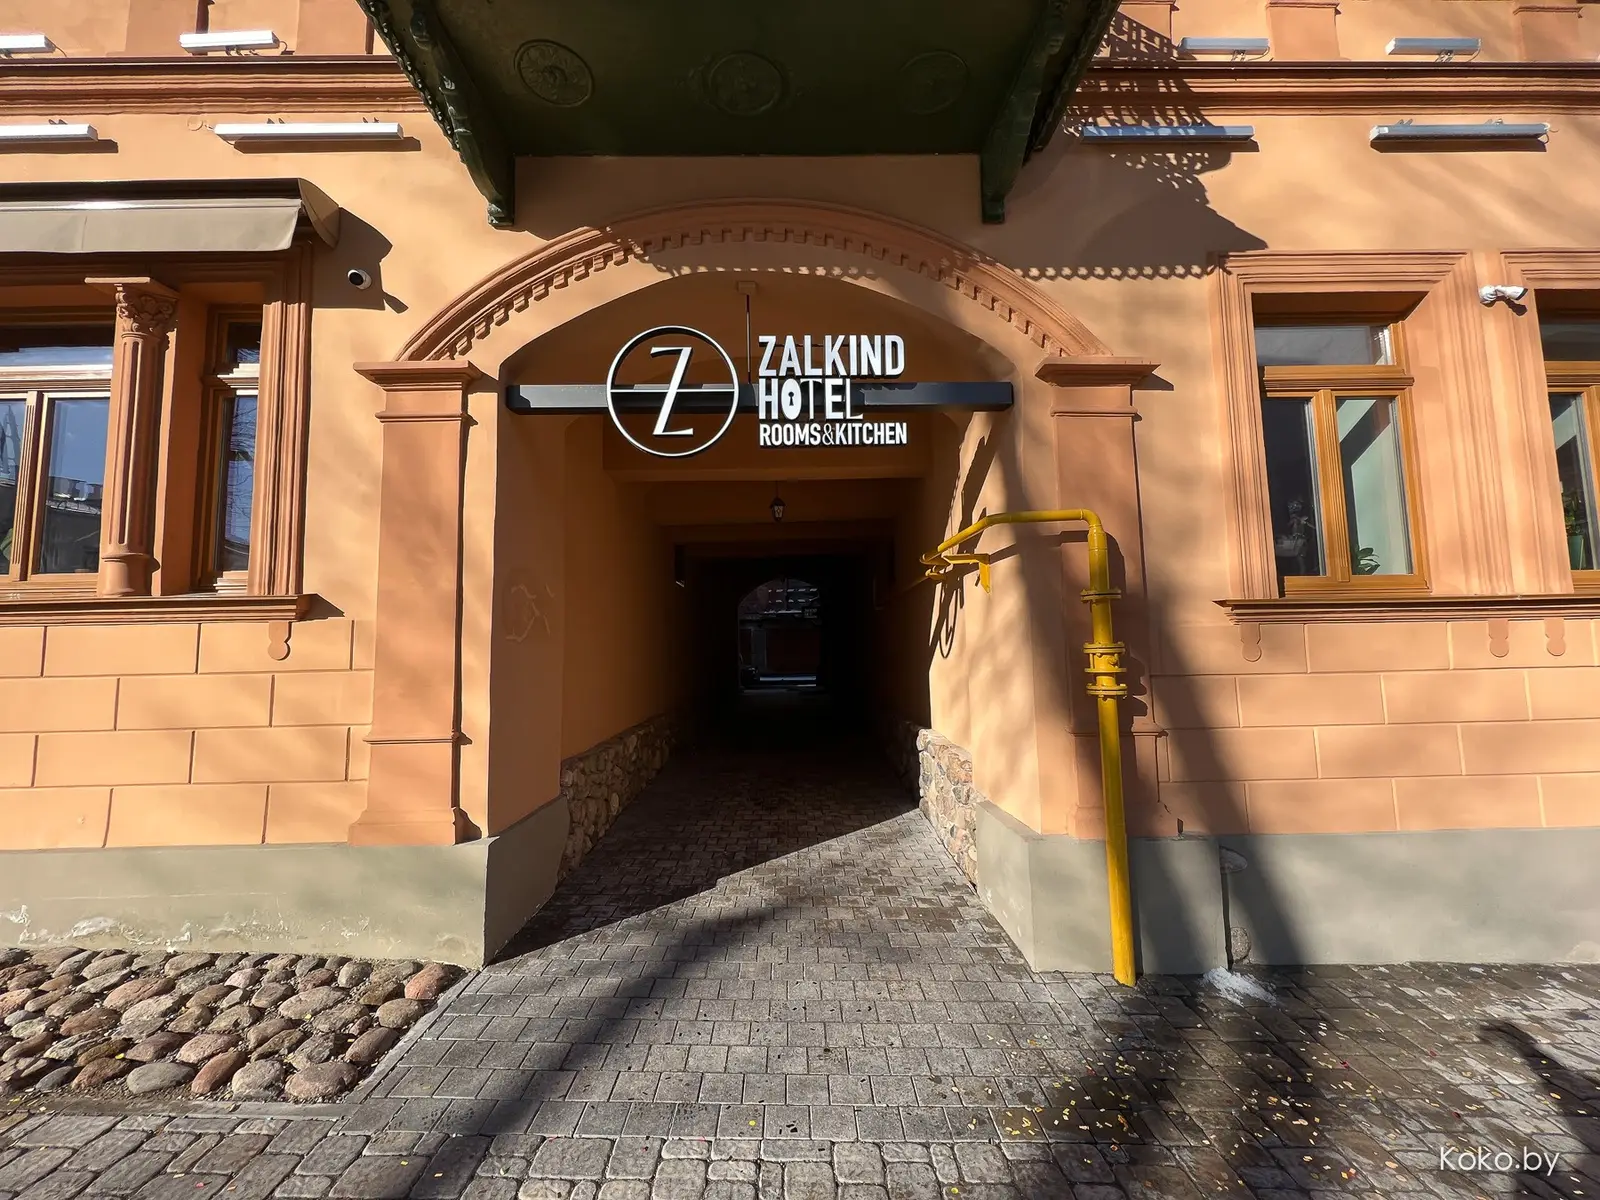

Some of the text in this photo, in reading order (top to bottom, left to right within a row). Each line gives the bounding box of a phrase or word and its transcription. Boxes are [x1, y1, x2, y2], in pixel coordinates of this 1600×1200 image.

[758, 335, 905, 376] ZALKIND
[650, 346, 693, 436] Z
[758, 378, 863, 420] HOTEL
[759, 422, 907, 446] ROOMS&KITCHEN
